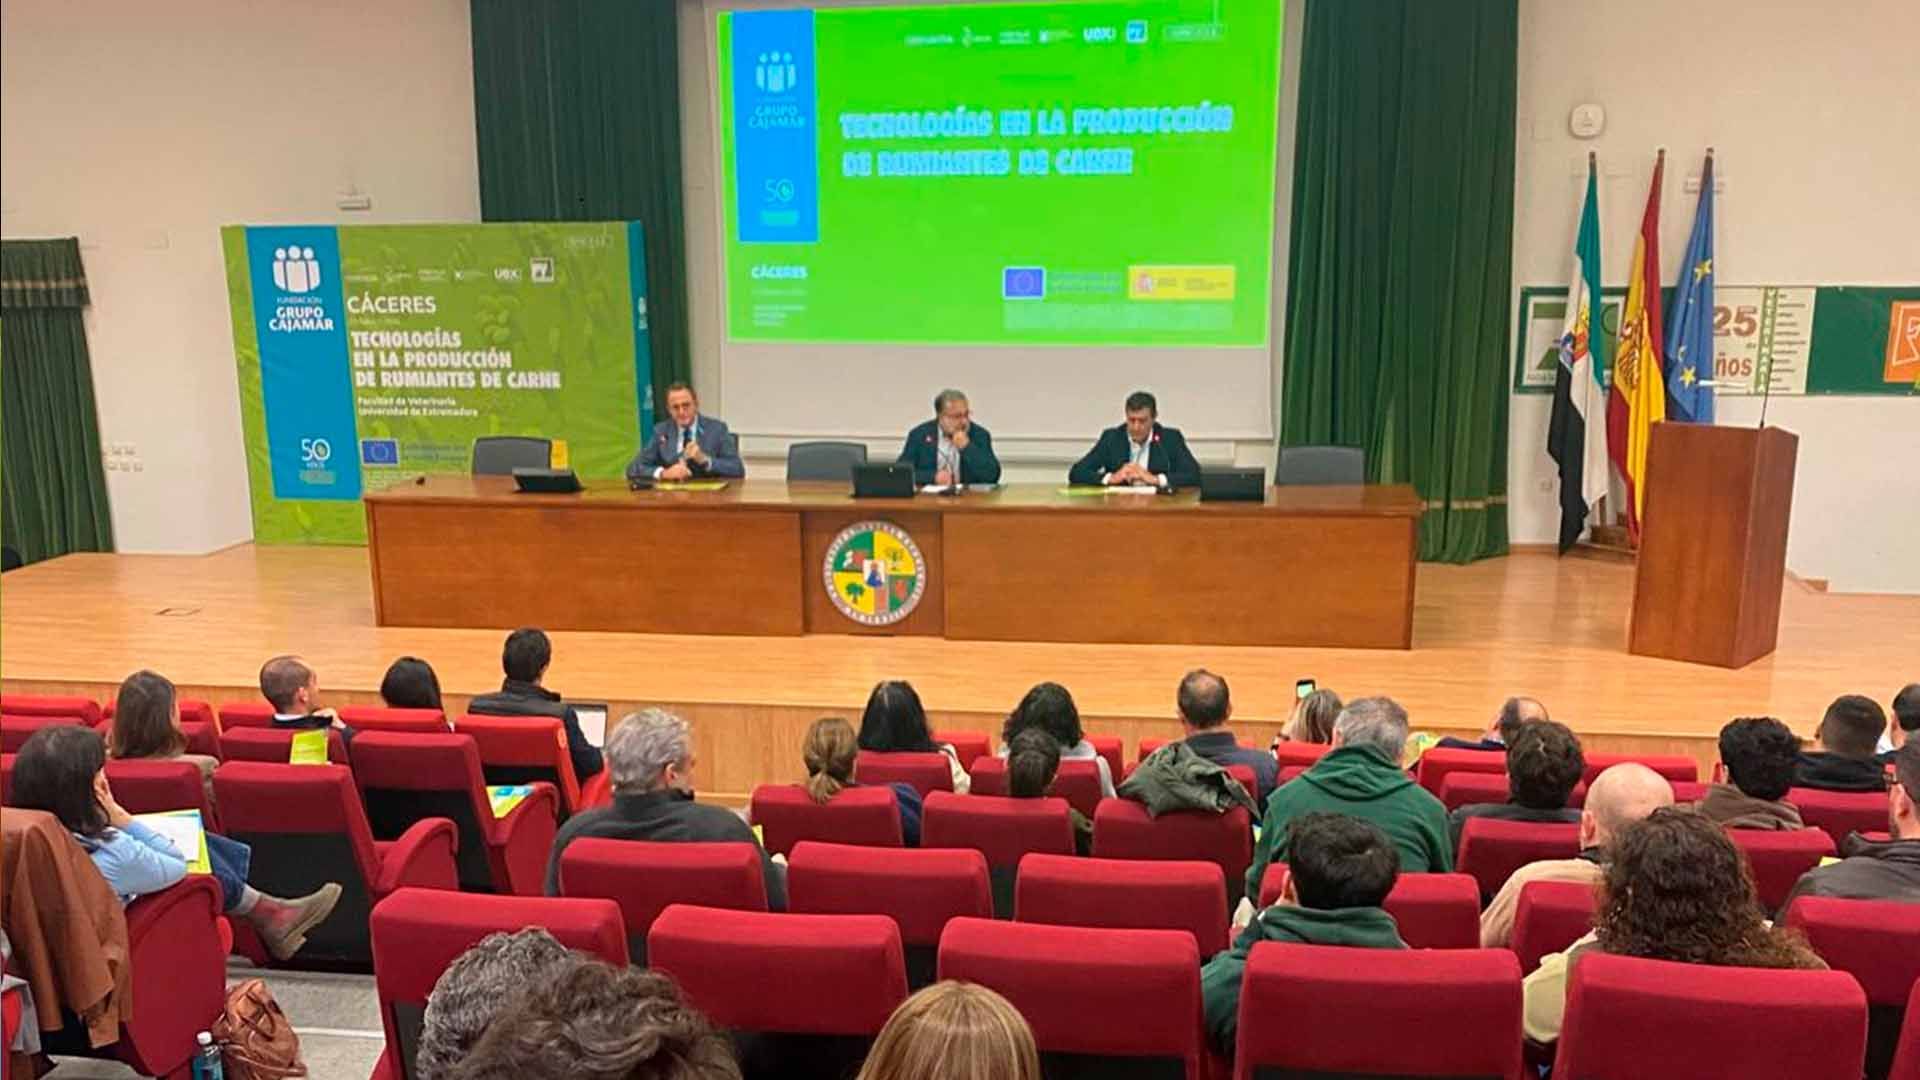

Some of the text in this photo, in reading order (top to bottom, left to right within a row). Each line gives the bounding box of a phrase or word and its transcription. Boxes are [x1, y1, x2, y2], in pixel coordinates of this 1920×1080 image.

[840, 100, 1233, 139] TECNOLOGÍAS EN LA PRODUCCIÓN
[843, 148, 1133, 176] DE RUMIANTES DE CARNE
[276, 306, 324, 318] GRUPO
[347, 290, 437, 314] CÁCERES
[269, 318, 334, 333] CAJAMAR
[1713, 305, 1757, 336] 25
[351, 327, 461, 348] TECNOLOGÍAS
[354, 347, 512, 368] EN LA PRODUCCIÓN
[1715, 352, 1753, 377] ños
[356, 371, 561, 388] DE RUMIANTES DE CARNE
[395, 397, 406, 405] de
[359, 407, 478, 417] Universidad de Extremadura
[301, 438, 331, 461] 50
